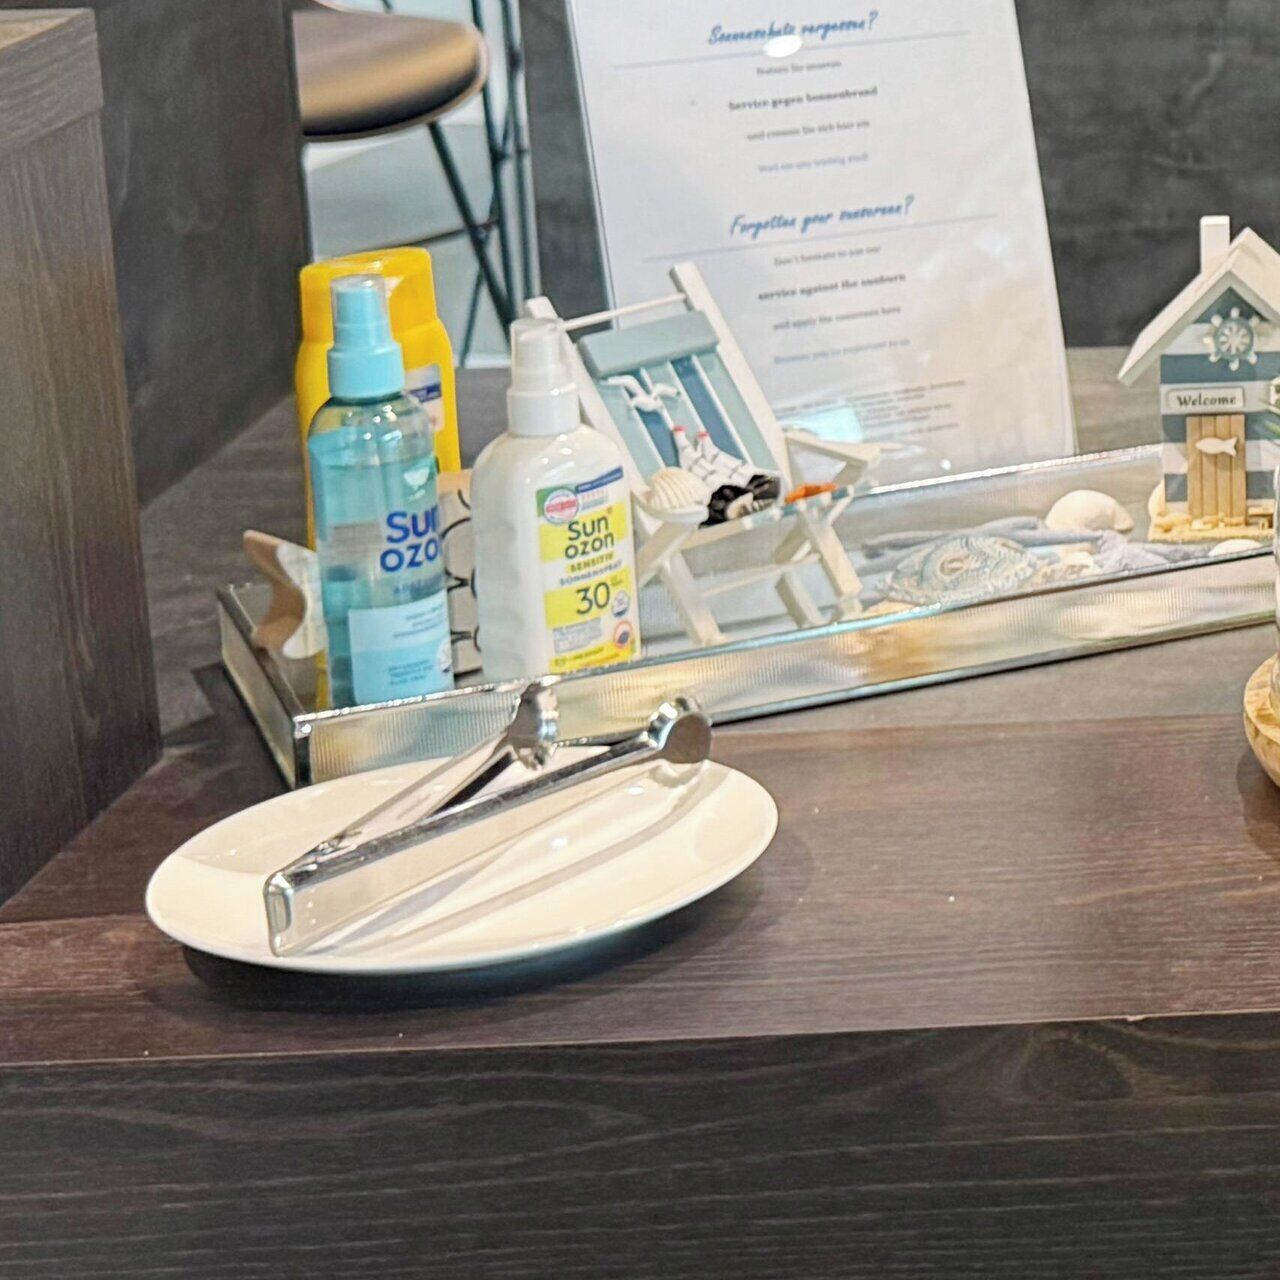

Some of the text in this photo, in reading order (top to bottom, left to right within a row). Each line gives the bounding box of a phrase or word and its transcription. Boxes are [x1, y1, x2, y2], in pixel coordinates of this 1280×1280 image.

[1176, 392, 1237, 407] Welcome
[567, 516, 610, 542] Sun
[564, 533, 616, 560] ozon
[575, 581, 612, 616] 30
